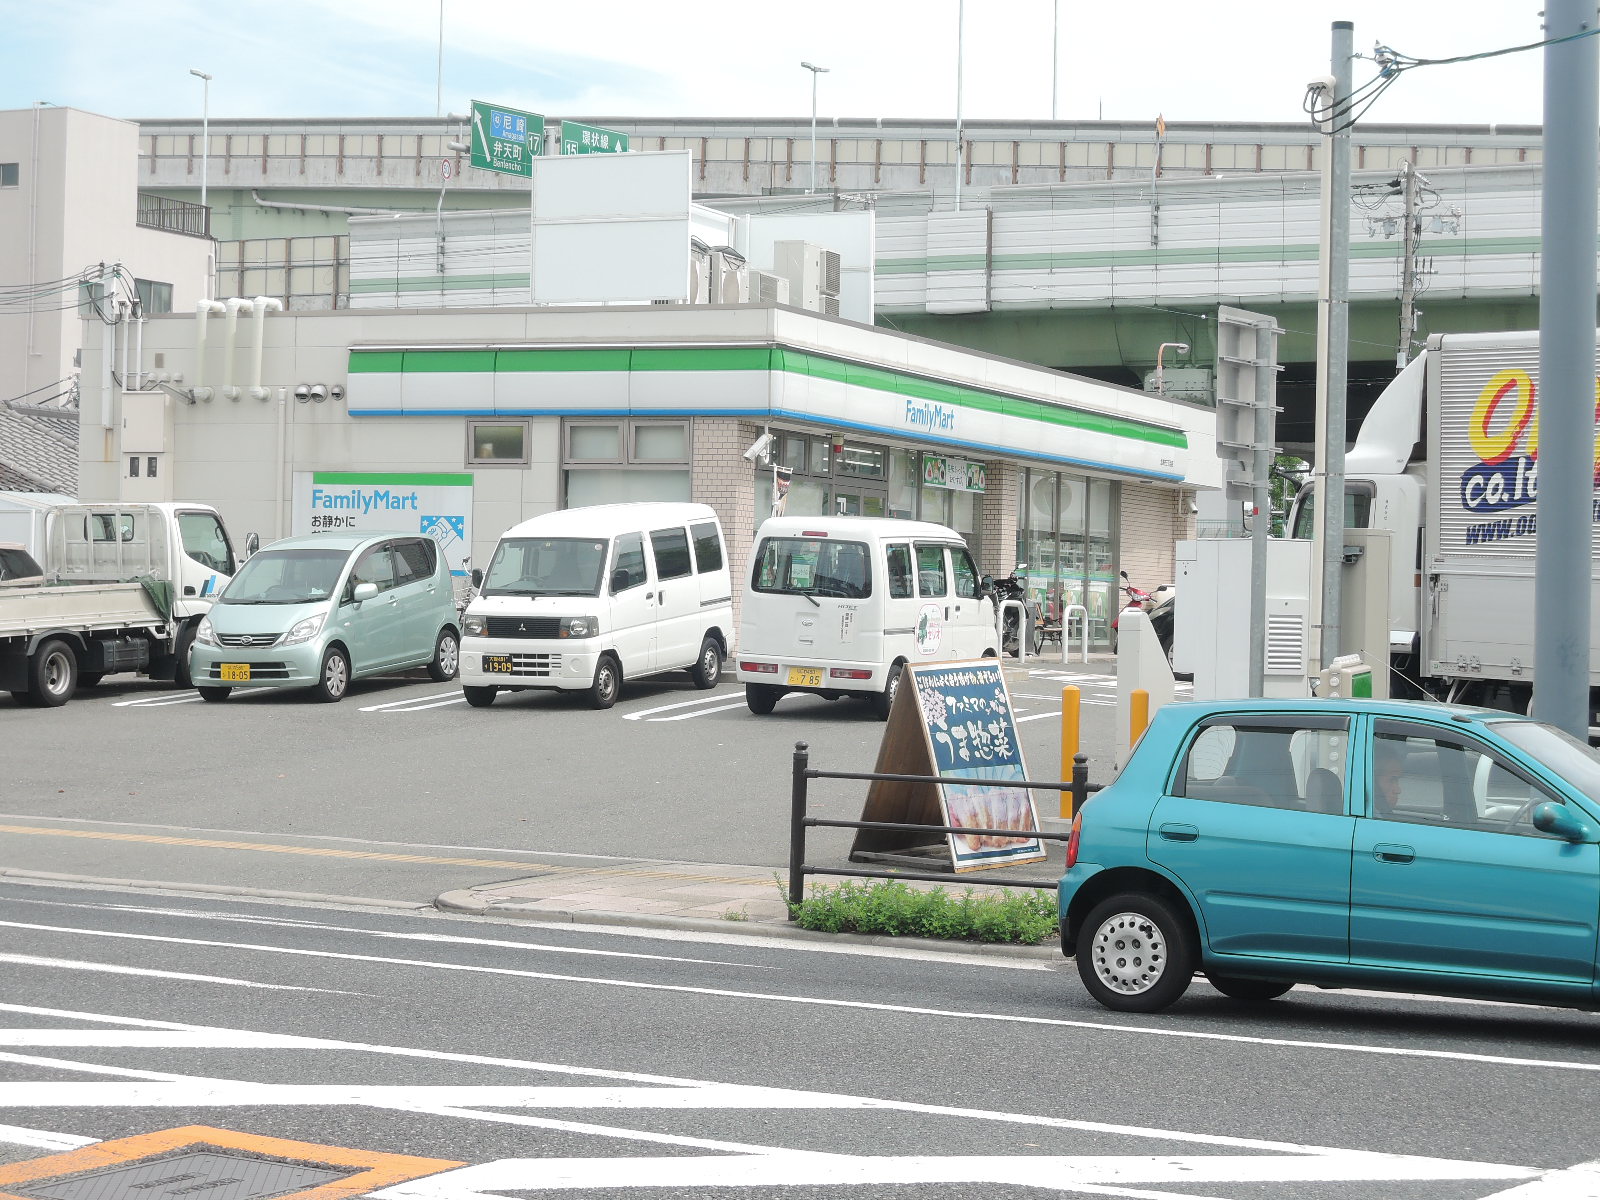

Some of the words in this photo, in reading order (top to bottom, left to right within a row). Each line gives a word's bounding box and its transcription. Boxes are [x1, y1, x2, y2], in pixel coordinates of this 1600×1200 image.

[503, 115, 525, 133] 尼崎
[529, 135, 539, 152] 17
[566, 143, 577, 155] 15
[582, 130, 609, 149] 環状線
[493, 140, 523, 161] 弁天町
[905, 399, 955, 432] FamilyMart
[311, 488, 418, 515] FamilyMart
[311, 515, 356, 528] お静かに
[945, 695, 987, 715] ファミマの
[935, 716, 1015, 765] うま惣菜
